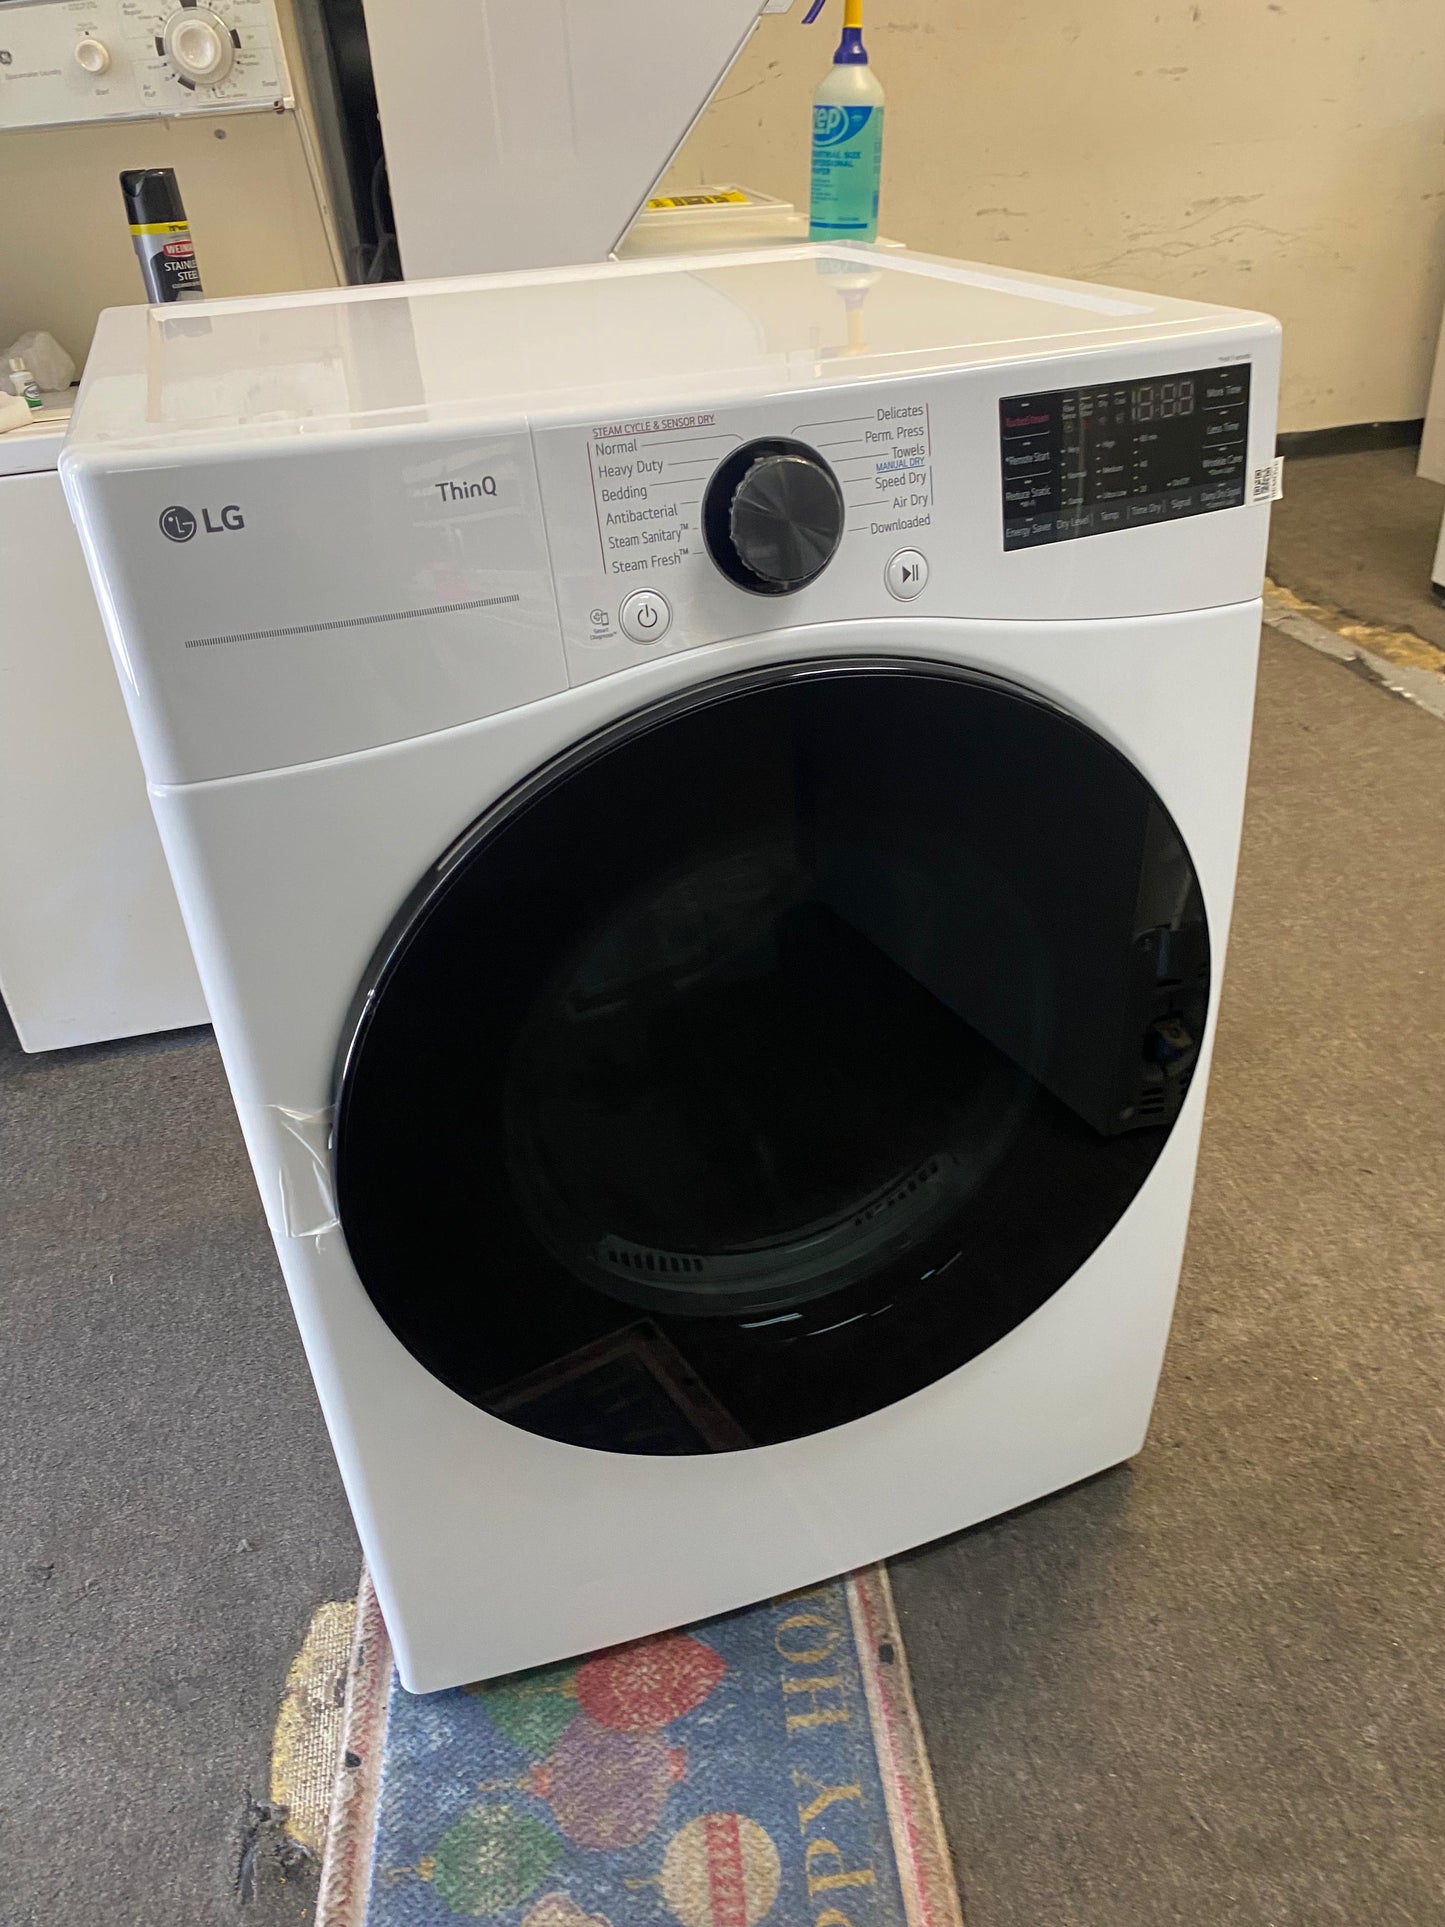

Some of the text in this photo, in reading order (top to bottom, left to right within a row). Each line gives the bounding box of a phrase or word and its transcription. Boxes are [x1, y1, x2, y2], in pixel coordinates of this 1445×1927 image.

[877, 406, 924, 421] Delicates
[592, 414, 715, 438] STEAM CYCLE & SENSOR DRY
[865, 426, 924, 443] Perm. Press
[595, 439, 638, 456] Normal
[891, 443, 925, 459] Towels
[598, 460, 663, 478] Heavy Duty
[876, 456, 925, 471] MANUAL DRY
[435, 475, 498, 502] ThinQ
[875, 471, 926, 491] Speed Dry
[601, 485, 647, 502] Bedding
[893, 494, 928, 509] Air Dry
[202, 504, 245, 533] LG
[606, 504, 678, 526] Antibacterial
[871, 513, 930, 535] Downloaded
[1006, 527, 1031, 538] Energy
[608, 535, 640, 549] Steam
[612, 559, 648, 574] Steam
